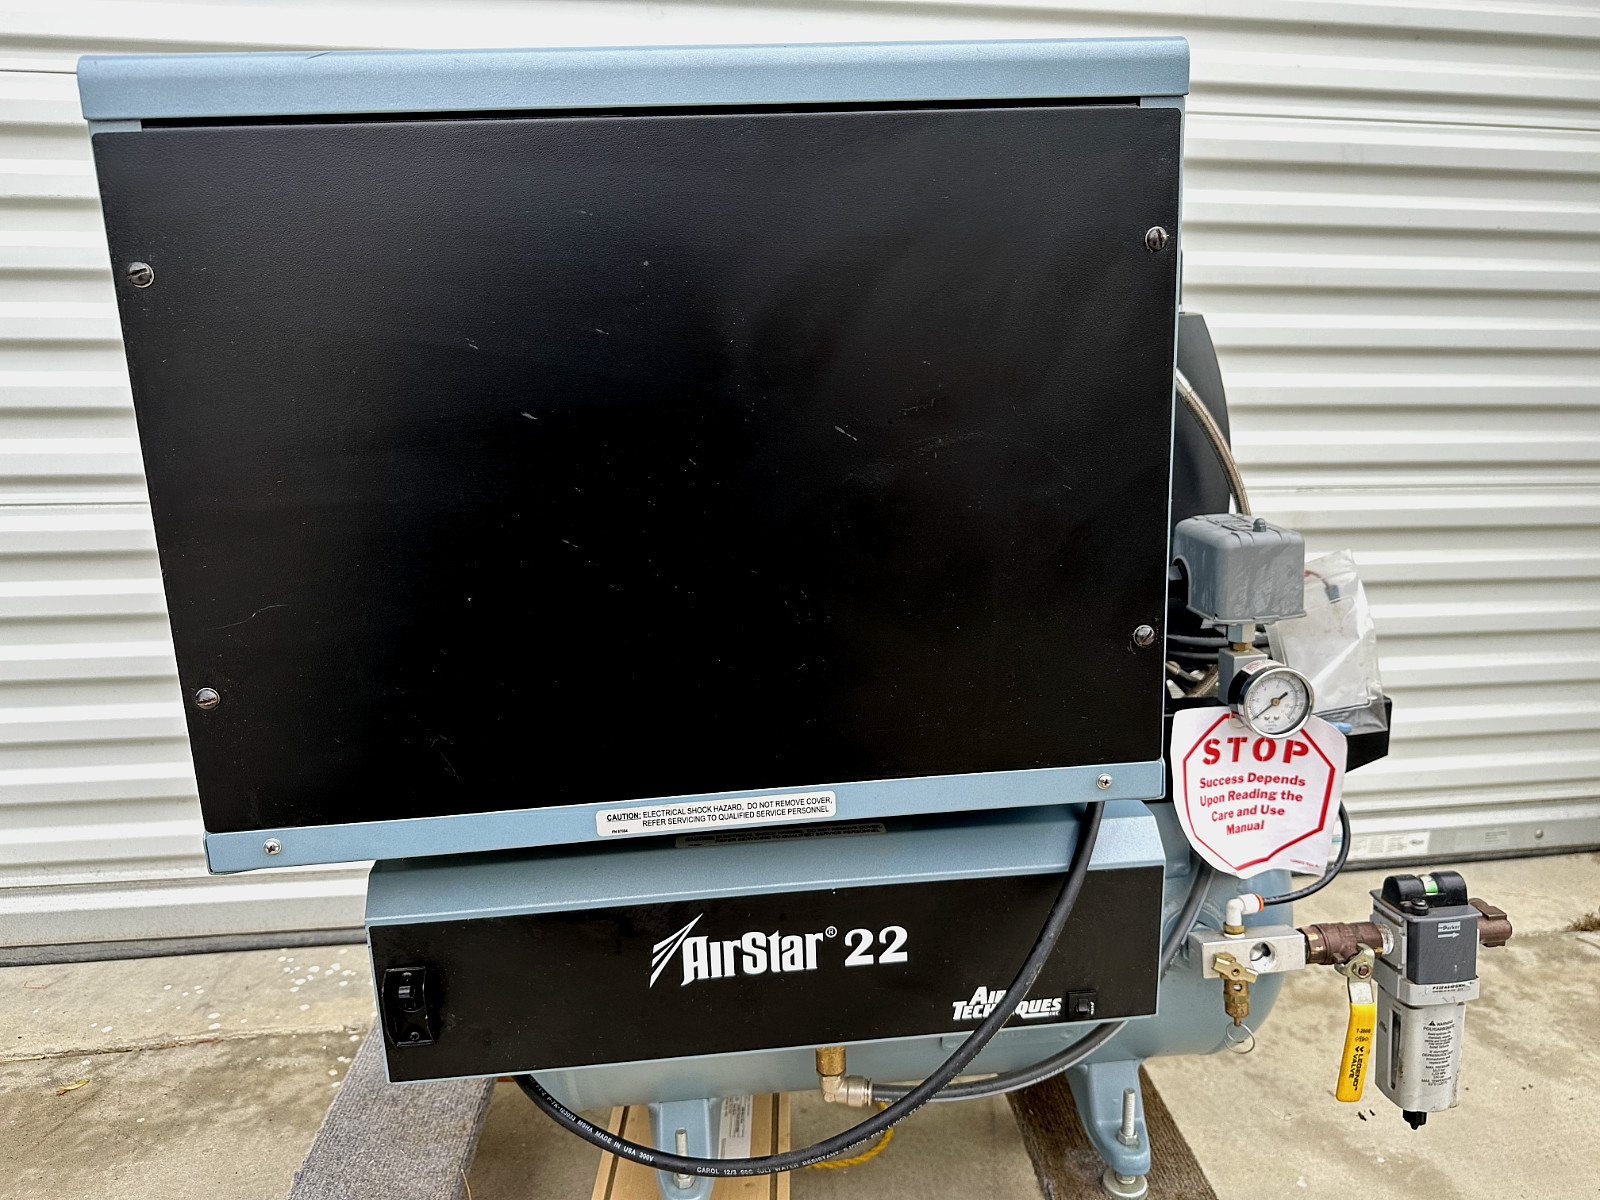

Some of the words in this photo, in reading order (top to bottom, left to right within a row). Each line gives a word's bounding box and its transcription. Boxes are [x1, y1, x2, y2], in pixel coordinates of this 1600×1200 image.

[1202, 737, 1309, 765] STOP
[1200, 775, 1244, 788] Success
[1247, 772, 1306, 787] Depends
[1200, 794, 1225, 807] Upon
[1227, 788, 1278, 802] Reading
[1280, 789, 1303, 802] the
[606, 812, 641, 822] CAUTION:
[643, 808, 686, 819] ELECTRICAL
[687, 806, 712, 815] SHOCK
[747, 802, 758, 810] DO
[759, 800, 774, 809] NOT
[775, 798, 805, 808] REMOVE
[642, 819, 666, 827] REFER
[667, 815, 706, 825] SERVICING
[708, 814, 717, 822] TO
[718, 811, 755, 820] QUALIFIED
[756, 808, 786, 817] SERVICE
[787, 806, 830, 815] PERSONNEL
[1211, 809, 1234, 822] Care
[1236, 805, 1257, 817] and
[1260, 805, 1285, 816] Use
[1226, 820, 1265, 835] Manual
[844, 925, 908, 967] 22
[952, 997, 1062, 1022] TECHQUES
[1349, 1053, 1358, 1079] VALVE
[576, 1119, 594, 1133] MSHA
[594, 1130, 612, 1144] MADE
[613, 1140, 621, 1149] IN
[623, 1146, 636, 1156] USA
[638, 1151, 655, 1162] 300V
[696, 1166, 720, 1174] CAROL
[774, 1162, 800, 1172] WATER
[802, 1150, 840, 1166] RESISTANT
